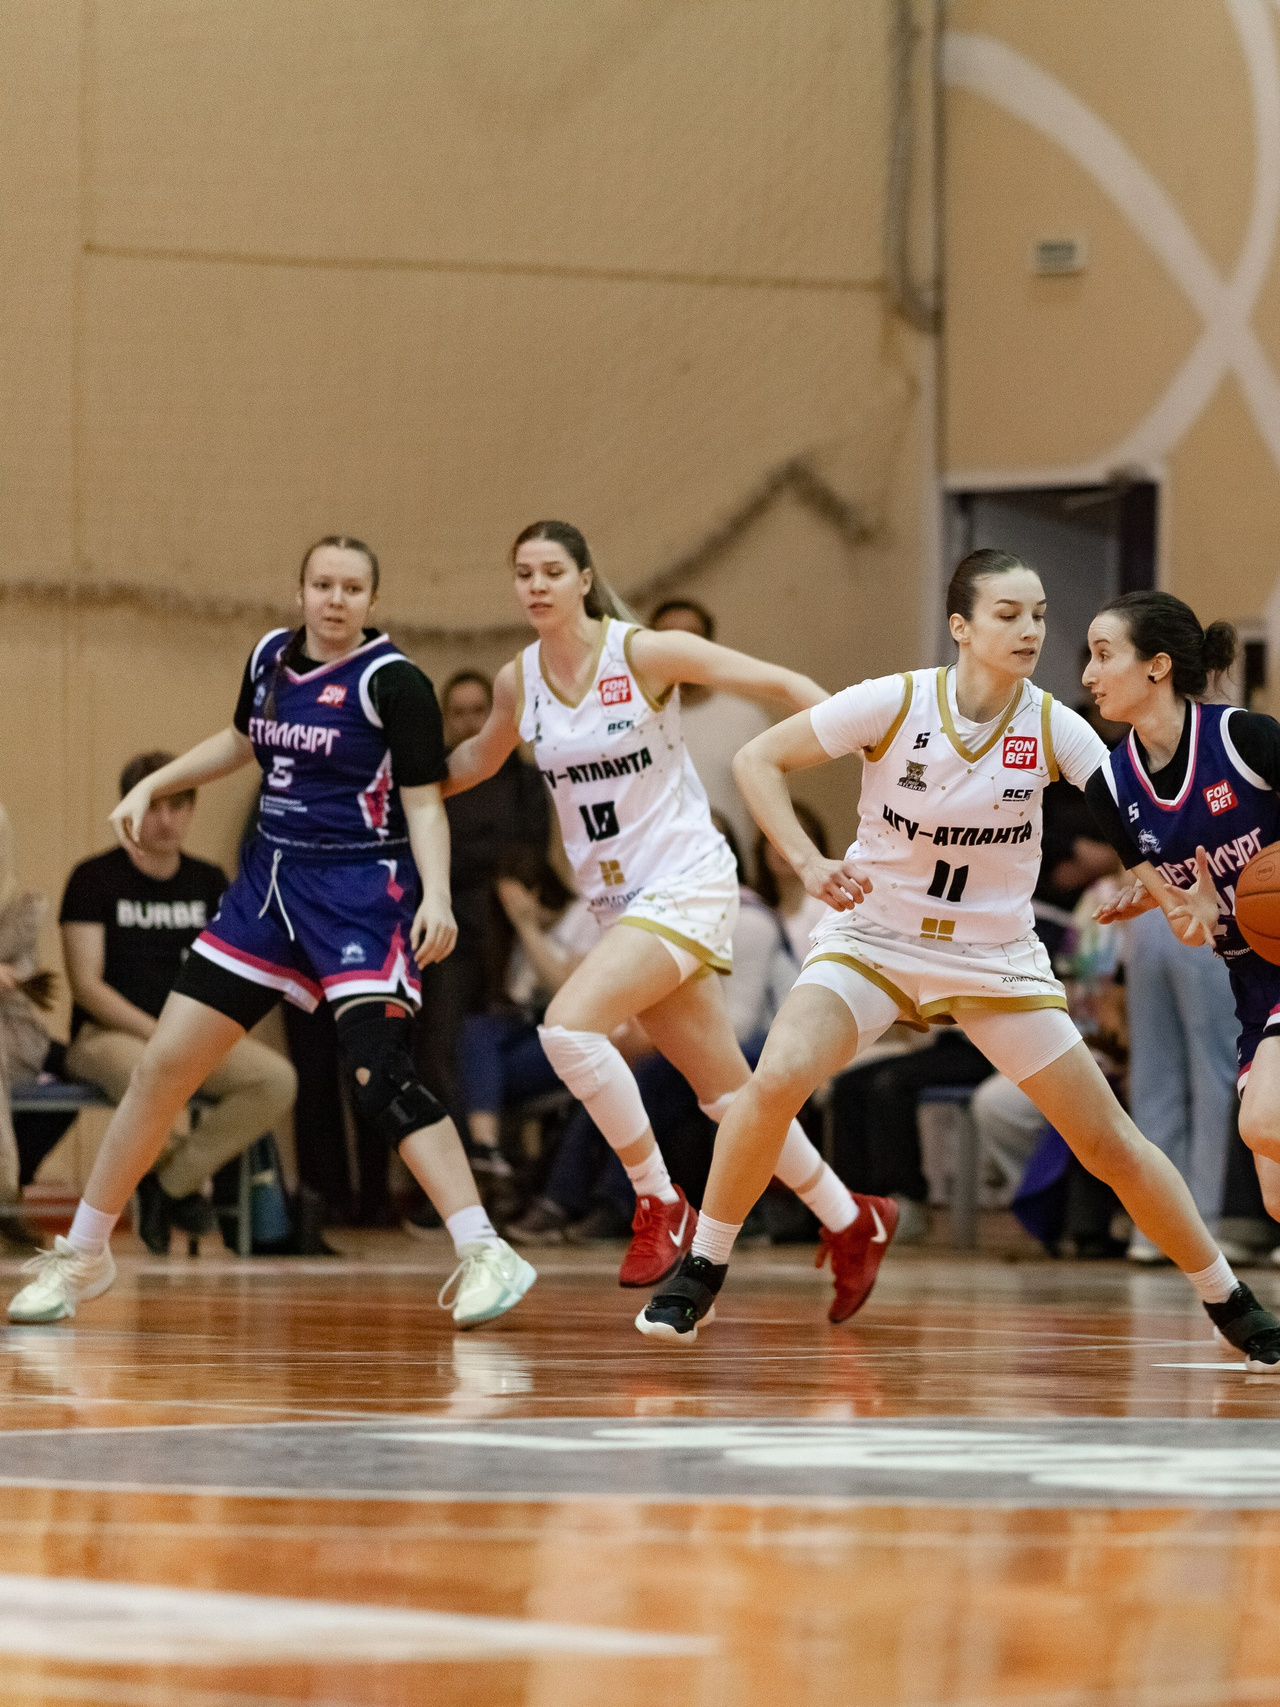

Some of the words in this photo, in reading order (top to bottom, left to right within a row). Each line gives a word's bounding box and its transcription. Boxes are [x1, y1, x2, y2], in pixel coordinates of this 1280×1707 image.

[1005, 740, 1035, 752] FON
[1005, 752, 1034, 765] BET
[268, 755, 295, 788] 5
[1206, 782, 1229, 802] FON
[1211, 792, 1232, 813] BET
[579, 801, 619, 842] 10
[882, 804, 1033, 846] ЧГУ-АТЛАНТА
[927, 859, 969, 902] 11
